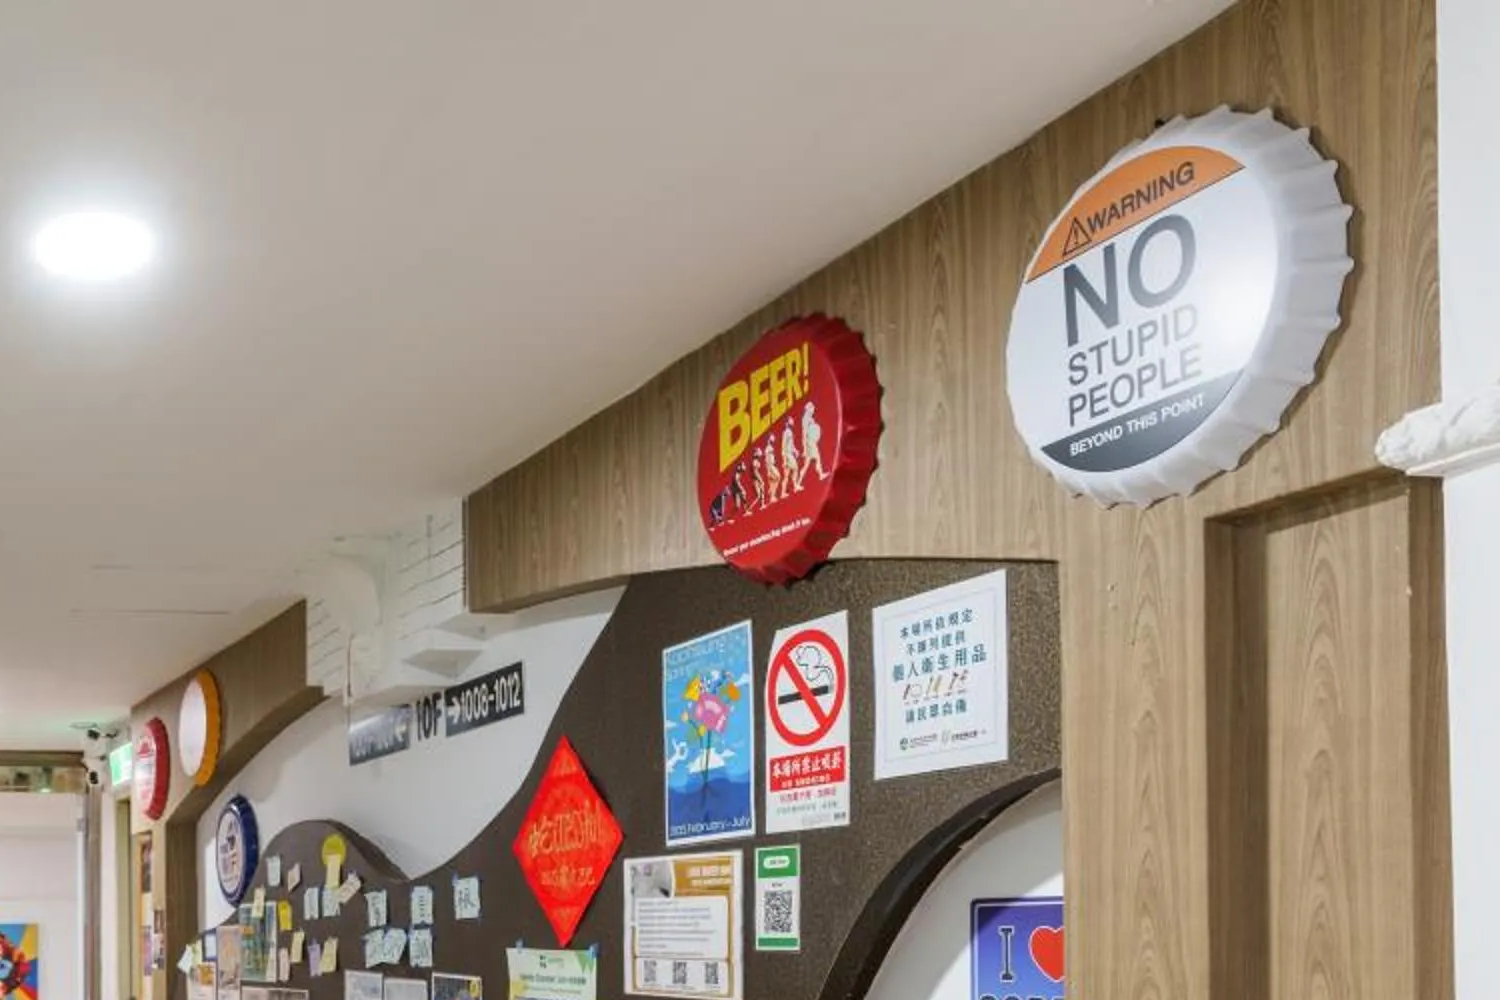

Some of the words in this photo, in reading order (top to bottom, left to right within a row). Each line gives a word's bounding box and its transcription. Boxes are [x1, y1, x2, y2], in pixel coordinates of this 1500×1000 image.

[1087, 160, 1196, 234] WARNING
[1062, 213, 1197, 348] NO
[1068, 302, 1199, 387] STUPID
[718, 341, 810, 474] BEER!
[1068, 343, 1203, 428] PEOPLE
[1069, 426, 1124, 457] BEYOND
[1126, 410, 1158, 435] THIS
[1161, 392, 1205, 422] POINT
[415, 691, 443, 741] 10F
[461, 671, 521, 724] 1008-1012
[998, 924, 1015, 982] I
